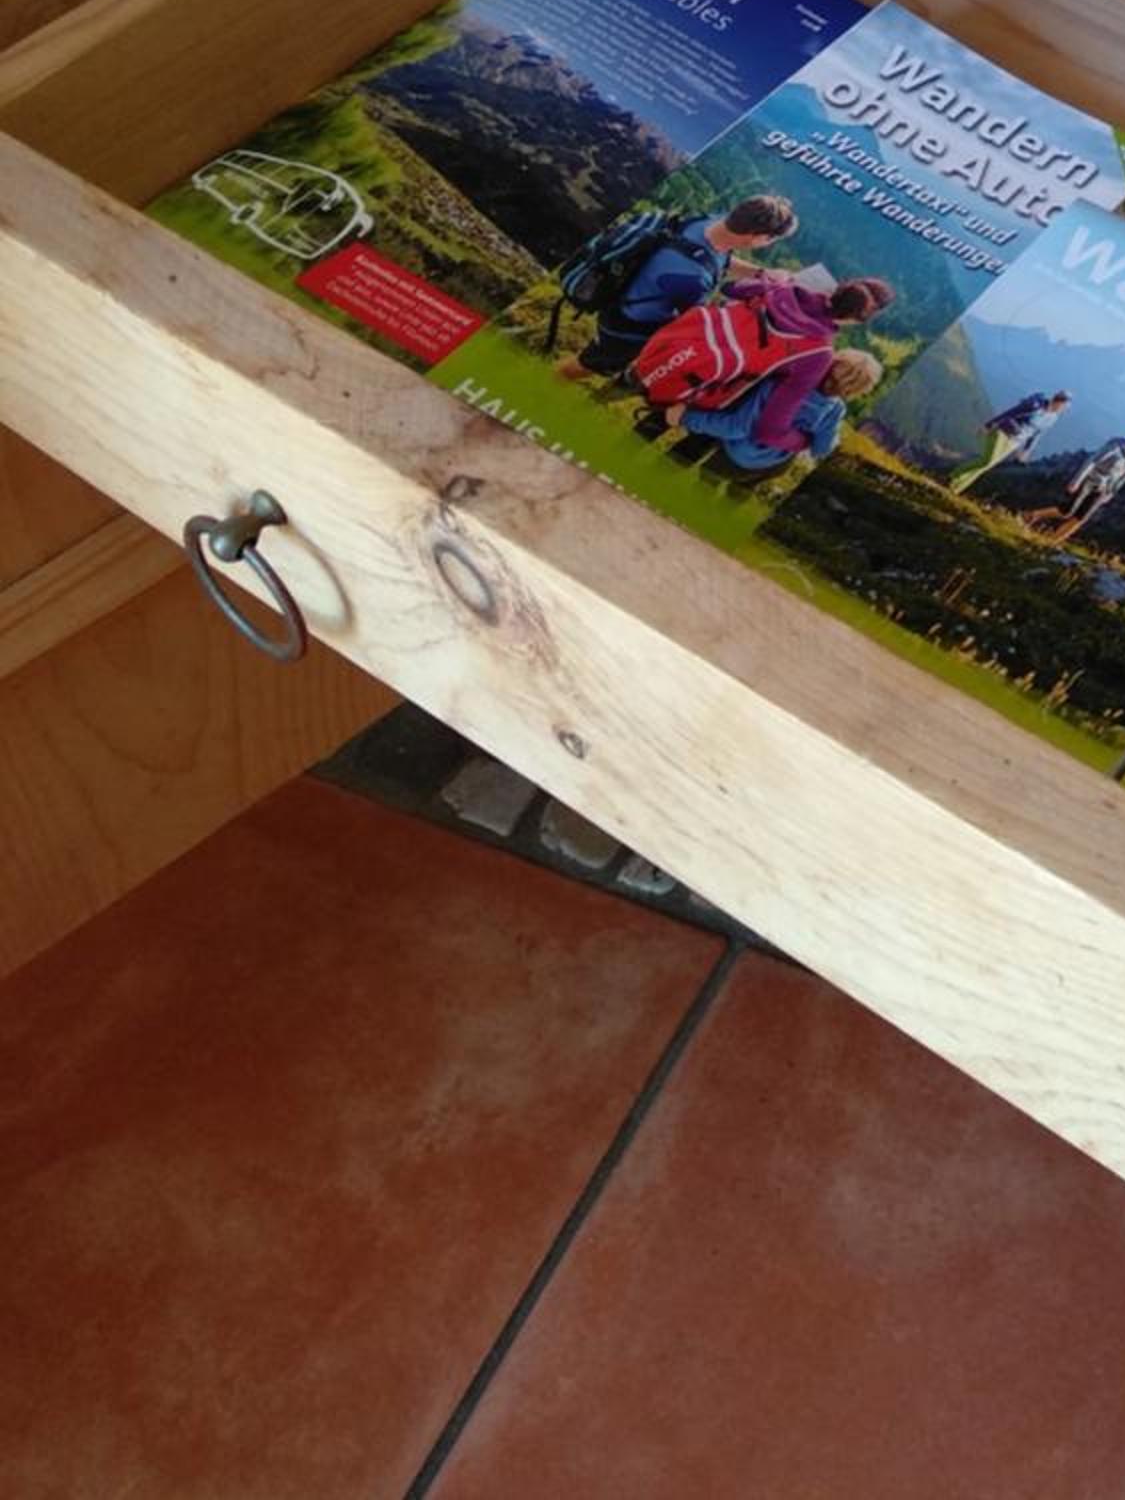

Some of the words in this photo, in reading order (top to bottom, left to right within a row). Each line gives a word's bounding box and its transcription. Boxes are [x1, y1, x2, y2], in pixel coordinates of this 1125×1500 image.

[822, 79, 949, 165] ohne
[877, 44, 1100, 190] Wandern
[762, 128, 863, 196] geführte
[963, 216, 1019, 246] und
